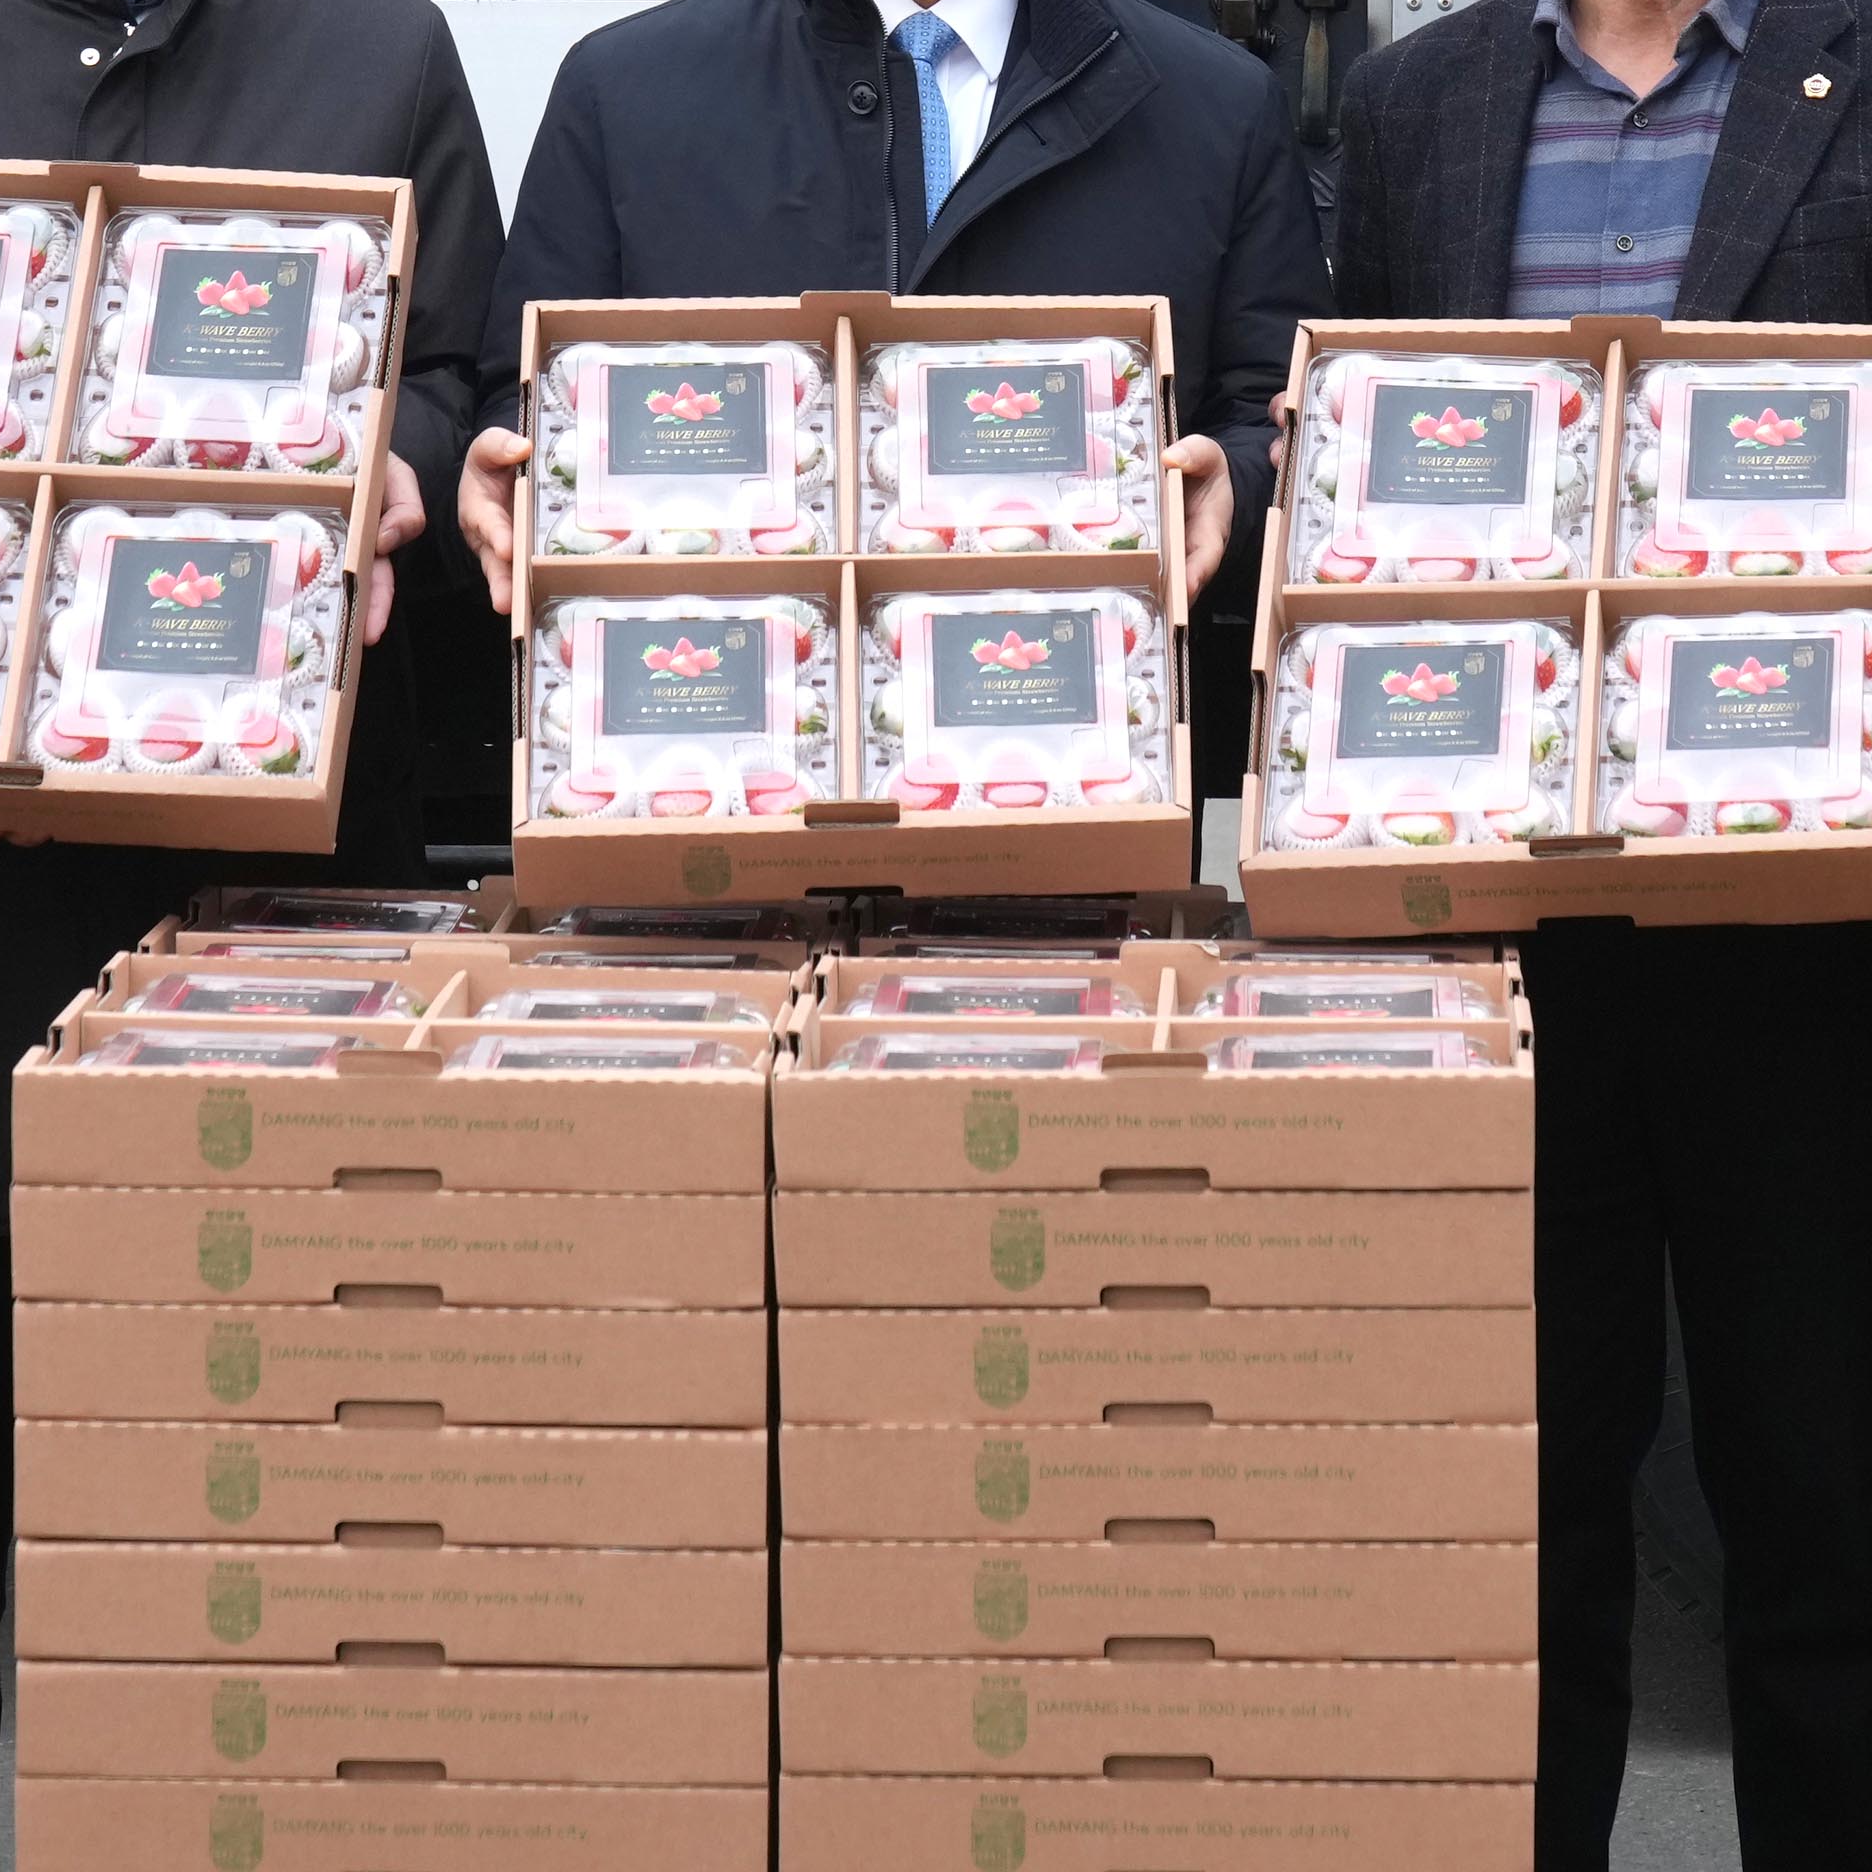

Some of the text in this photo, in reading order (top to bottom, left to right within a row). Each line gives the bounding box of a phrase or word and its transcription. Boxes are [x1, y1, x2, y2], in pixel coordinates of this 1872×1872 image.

[238, 325, 283, 338] BERRY
[694, 428, 739, 439] BERRY
[1013, 427, 1059, 438] BERRY
[1455, 456, 1501, 467] BERRY
[1774, 455, 1822, 465] BERRY
[188, 618, 235, 631] BERRY
[1020, 678, 1068, 689] BERRY
[692, 686, 737, 697] BERRY
[1756, 701, 1805, 713] BERRY
[1426, 709, 1475, 720] BERRY
[261, 1113, 575, 1134] DAMYANG the over 1000 years old city
[1028, 1113, 1344, 1131] DAMYANG the over 1000 years old city
[261, 1234, 574, 1254] DAMYANG the over 1000 years old city
[1053, 1233, 1370, 1249] DAMYANG the over 1000 years old city
[269, 1345, 583, 1368] DAMYANG the over 1000 years old city
[1039, 1466, 1355, 1482] DAMYANG the over 1000 years old city
